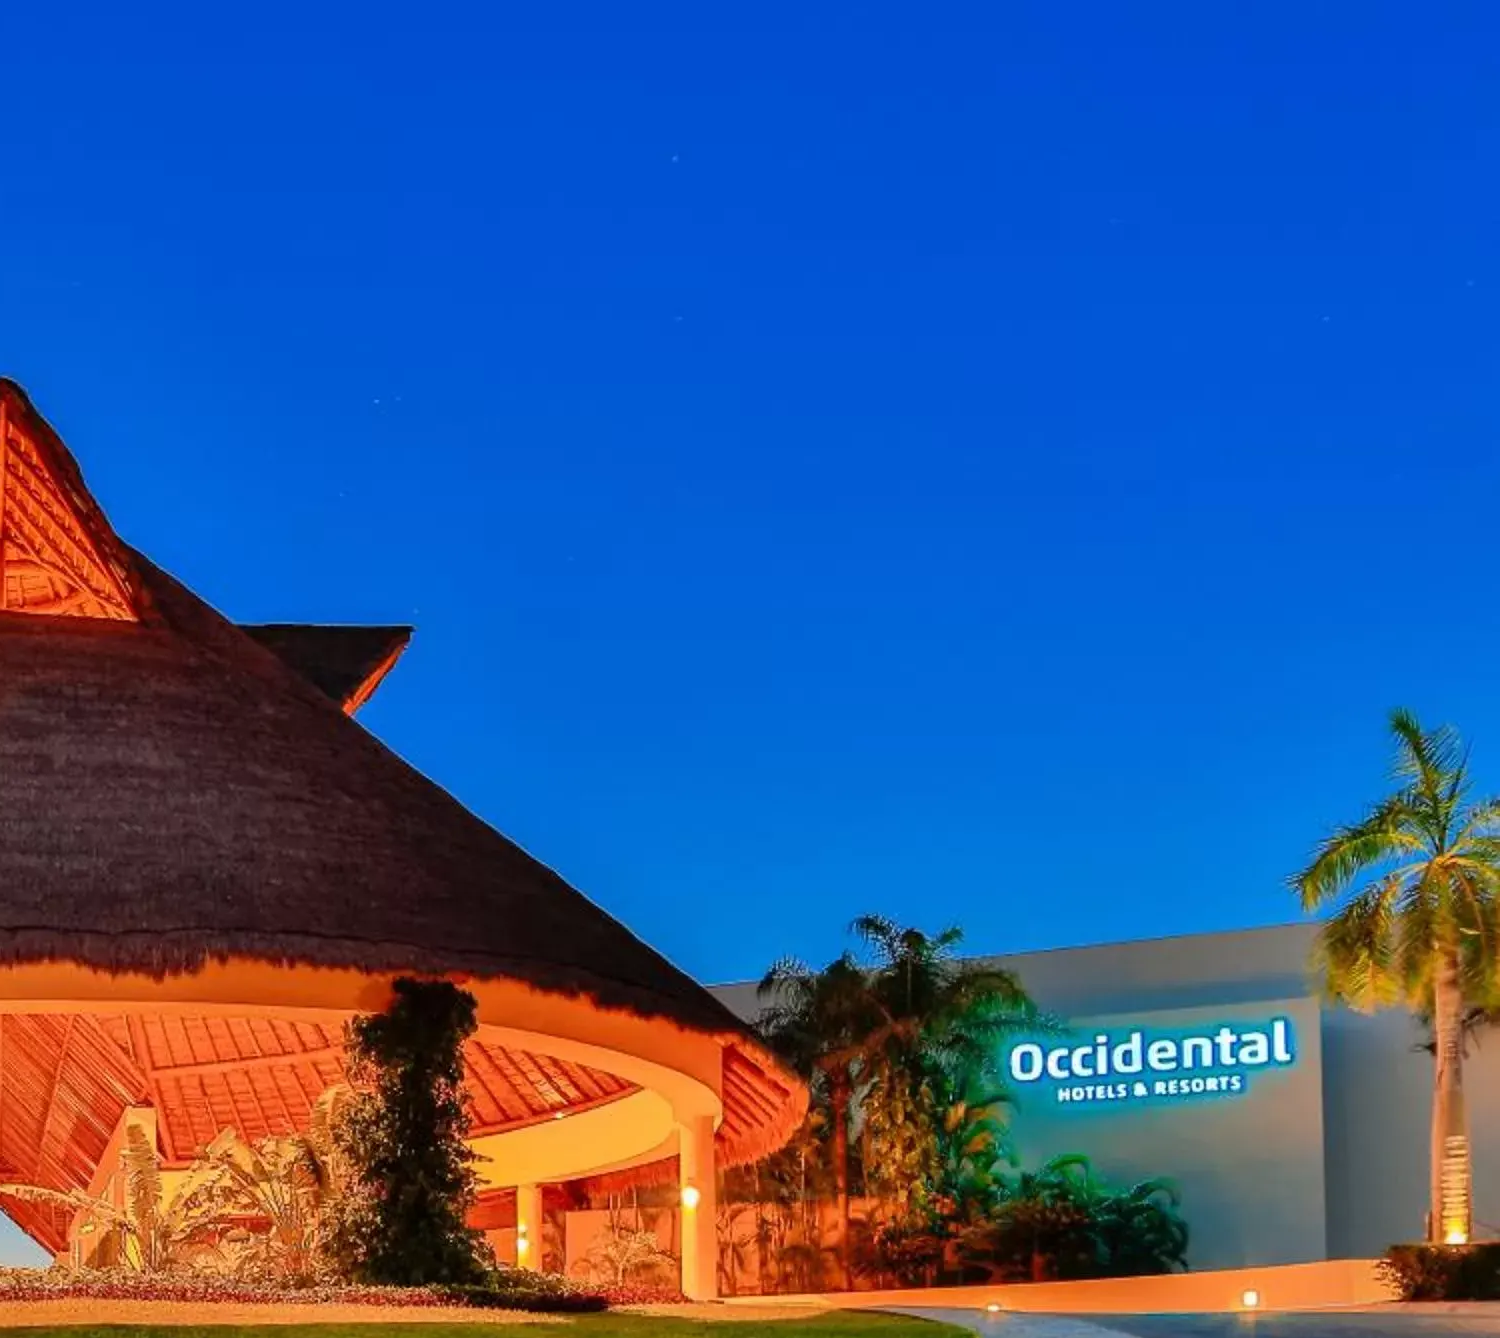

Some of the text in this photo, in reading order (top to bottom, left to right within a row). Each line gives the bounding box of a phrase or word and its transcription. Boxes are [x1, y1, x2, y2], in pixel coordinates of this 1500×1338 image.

[1010, 1019, 1292, 1081] Occidental
[1058, 1075, 1242, 1102] HOTELS & RESORTS
